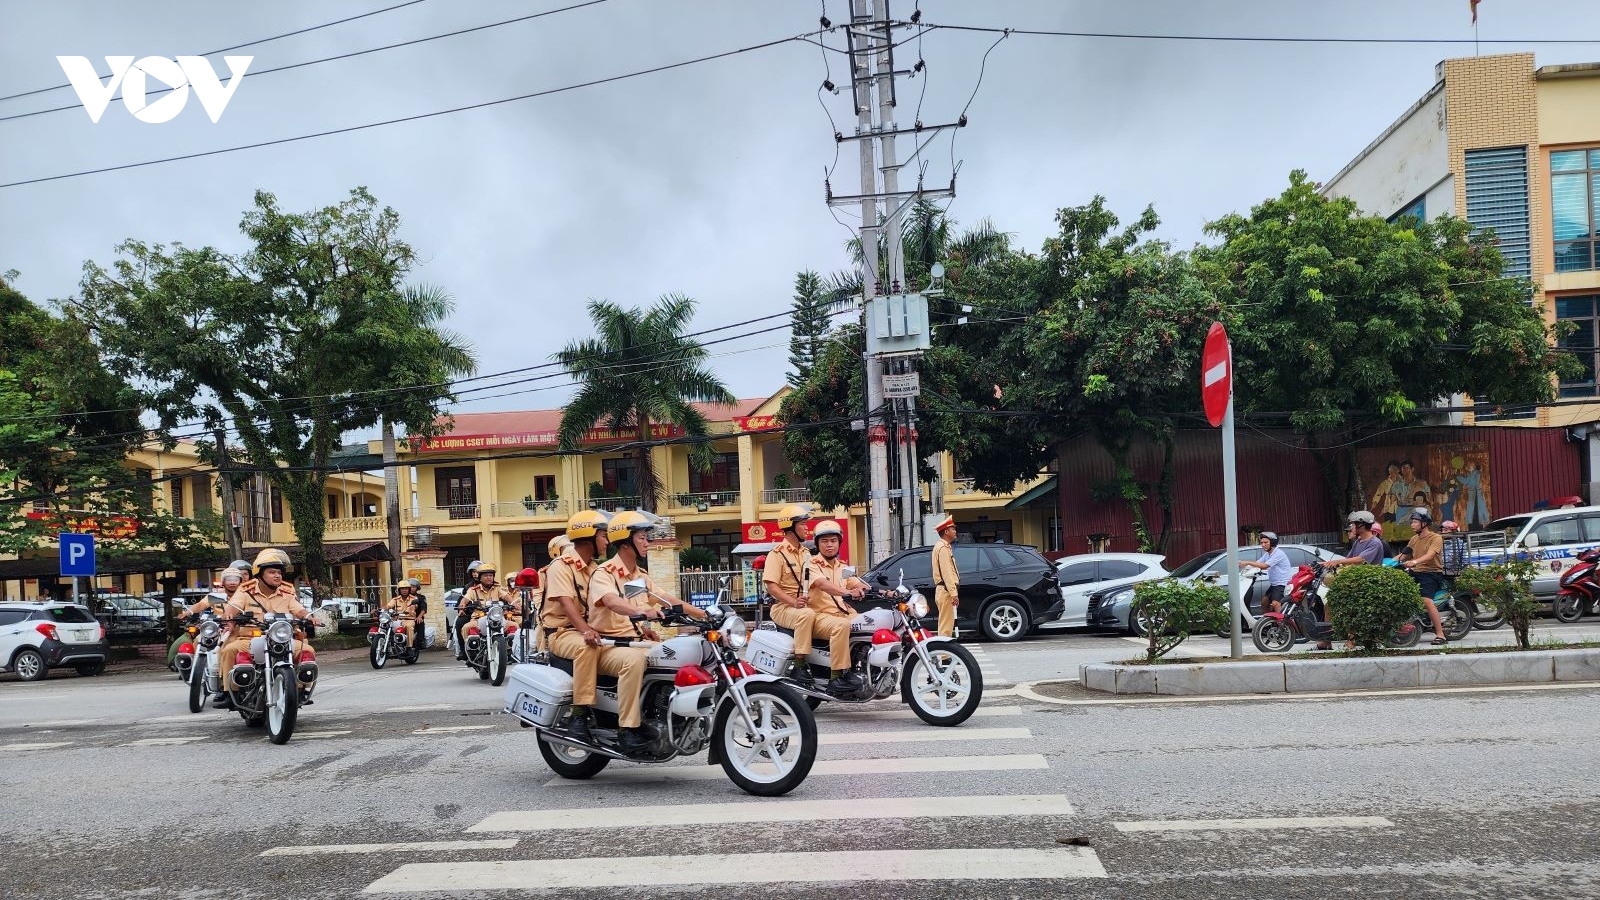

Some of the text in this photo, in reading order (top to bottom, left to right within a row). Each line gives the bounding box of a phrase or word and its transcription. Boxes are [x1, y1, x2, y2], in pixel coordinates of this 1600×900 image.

[441, 438, 465, 448] LƯỢNG
[466, 438, 484, 447] CSGT
[502, 434, 521, 445] NGÀY
[522, 433, 539, 444] LÀM
[571, 521, 593, 531] CSGT
[69, 542, 86, 566] P
[522, 700, 544, 717] CSGT
